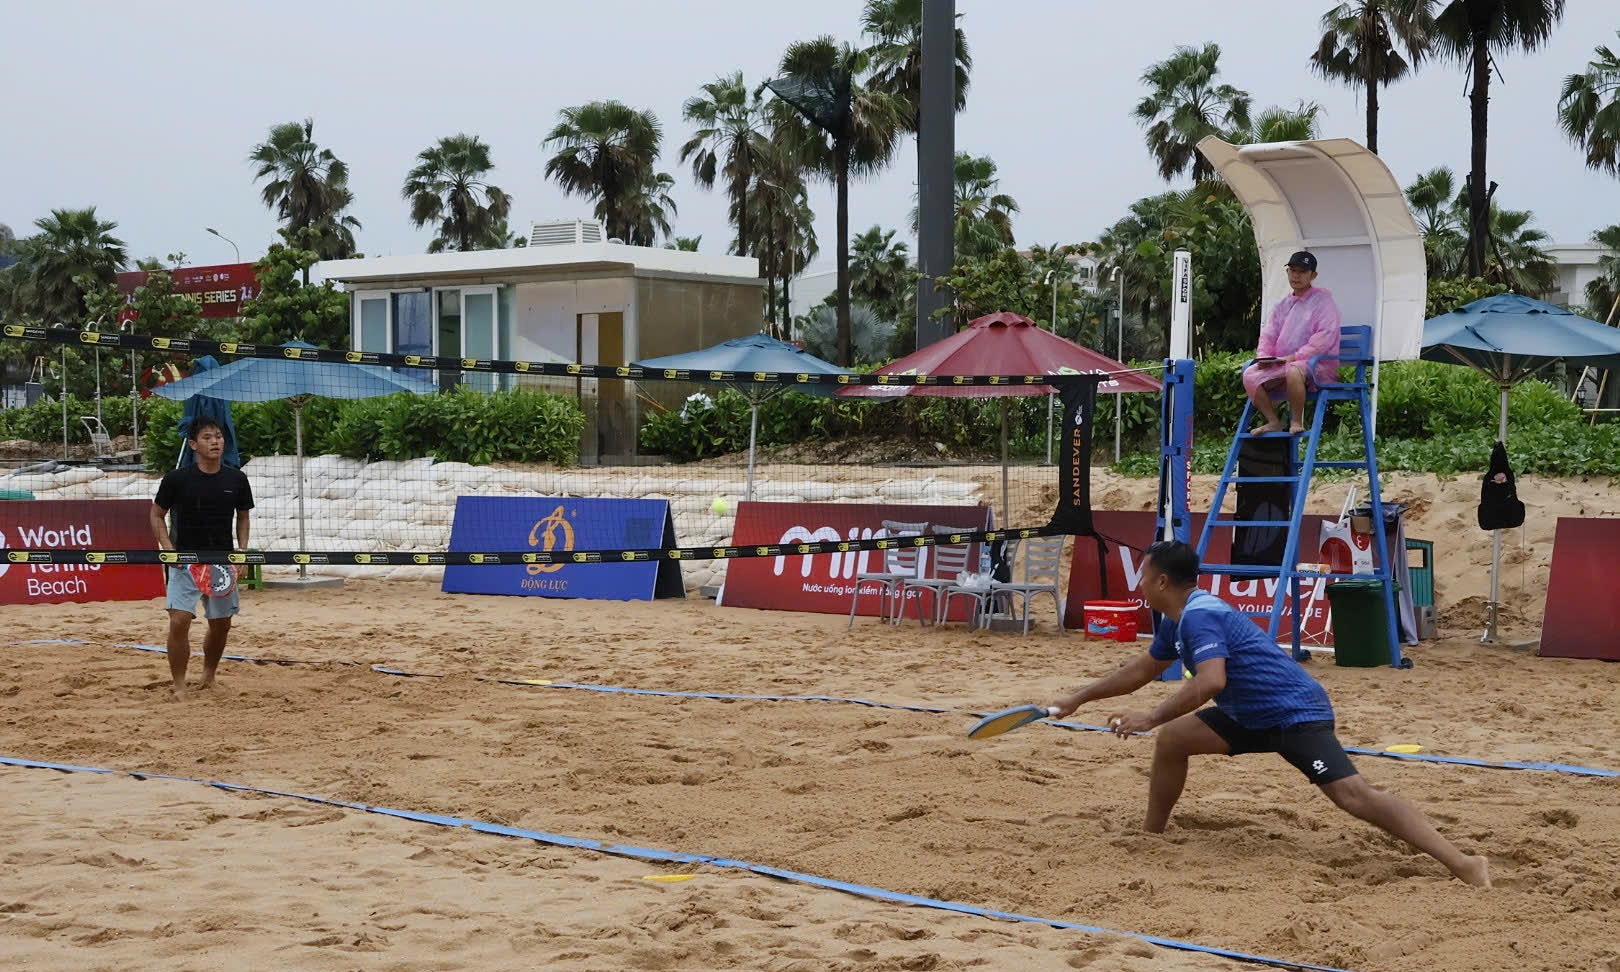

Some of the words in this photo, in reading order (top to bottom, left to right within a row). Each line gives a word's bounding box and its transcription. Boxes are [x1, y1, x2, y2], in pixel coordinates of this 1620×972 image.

[204, 289, 237, 304] SERIES
[1072, 428, 1081, 506] SANDEVER
[18, 525, 92, 547] World
[27, 576, 87, 596] Beach
[1238, 603, 1273, 613] YOUR
